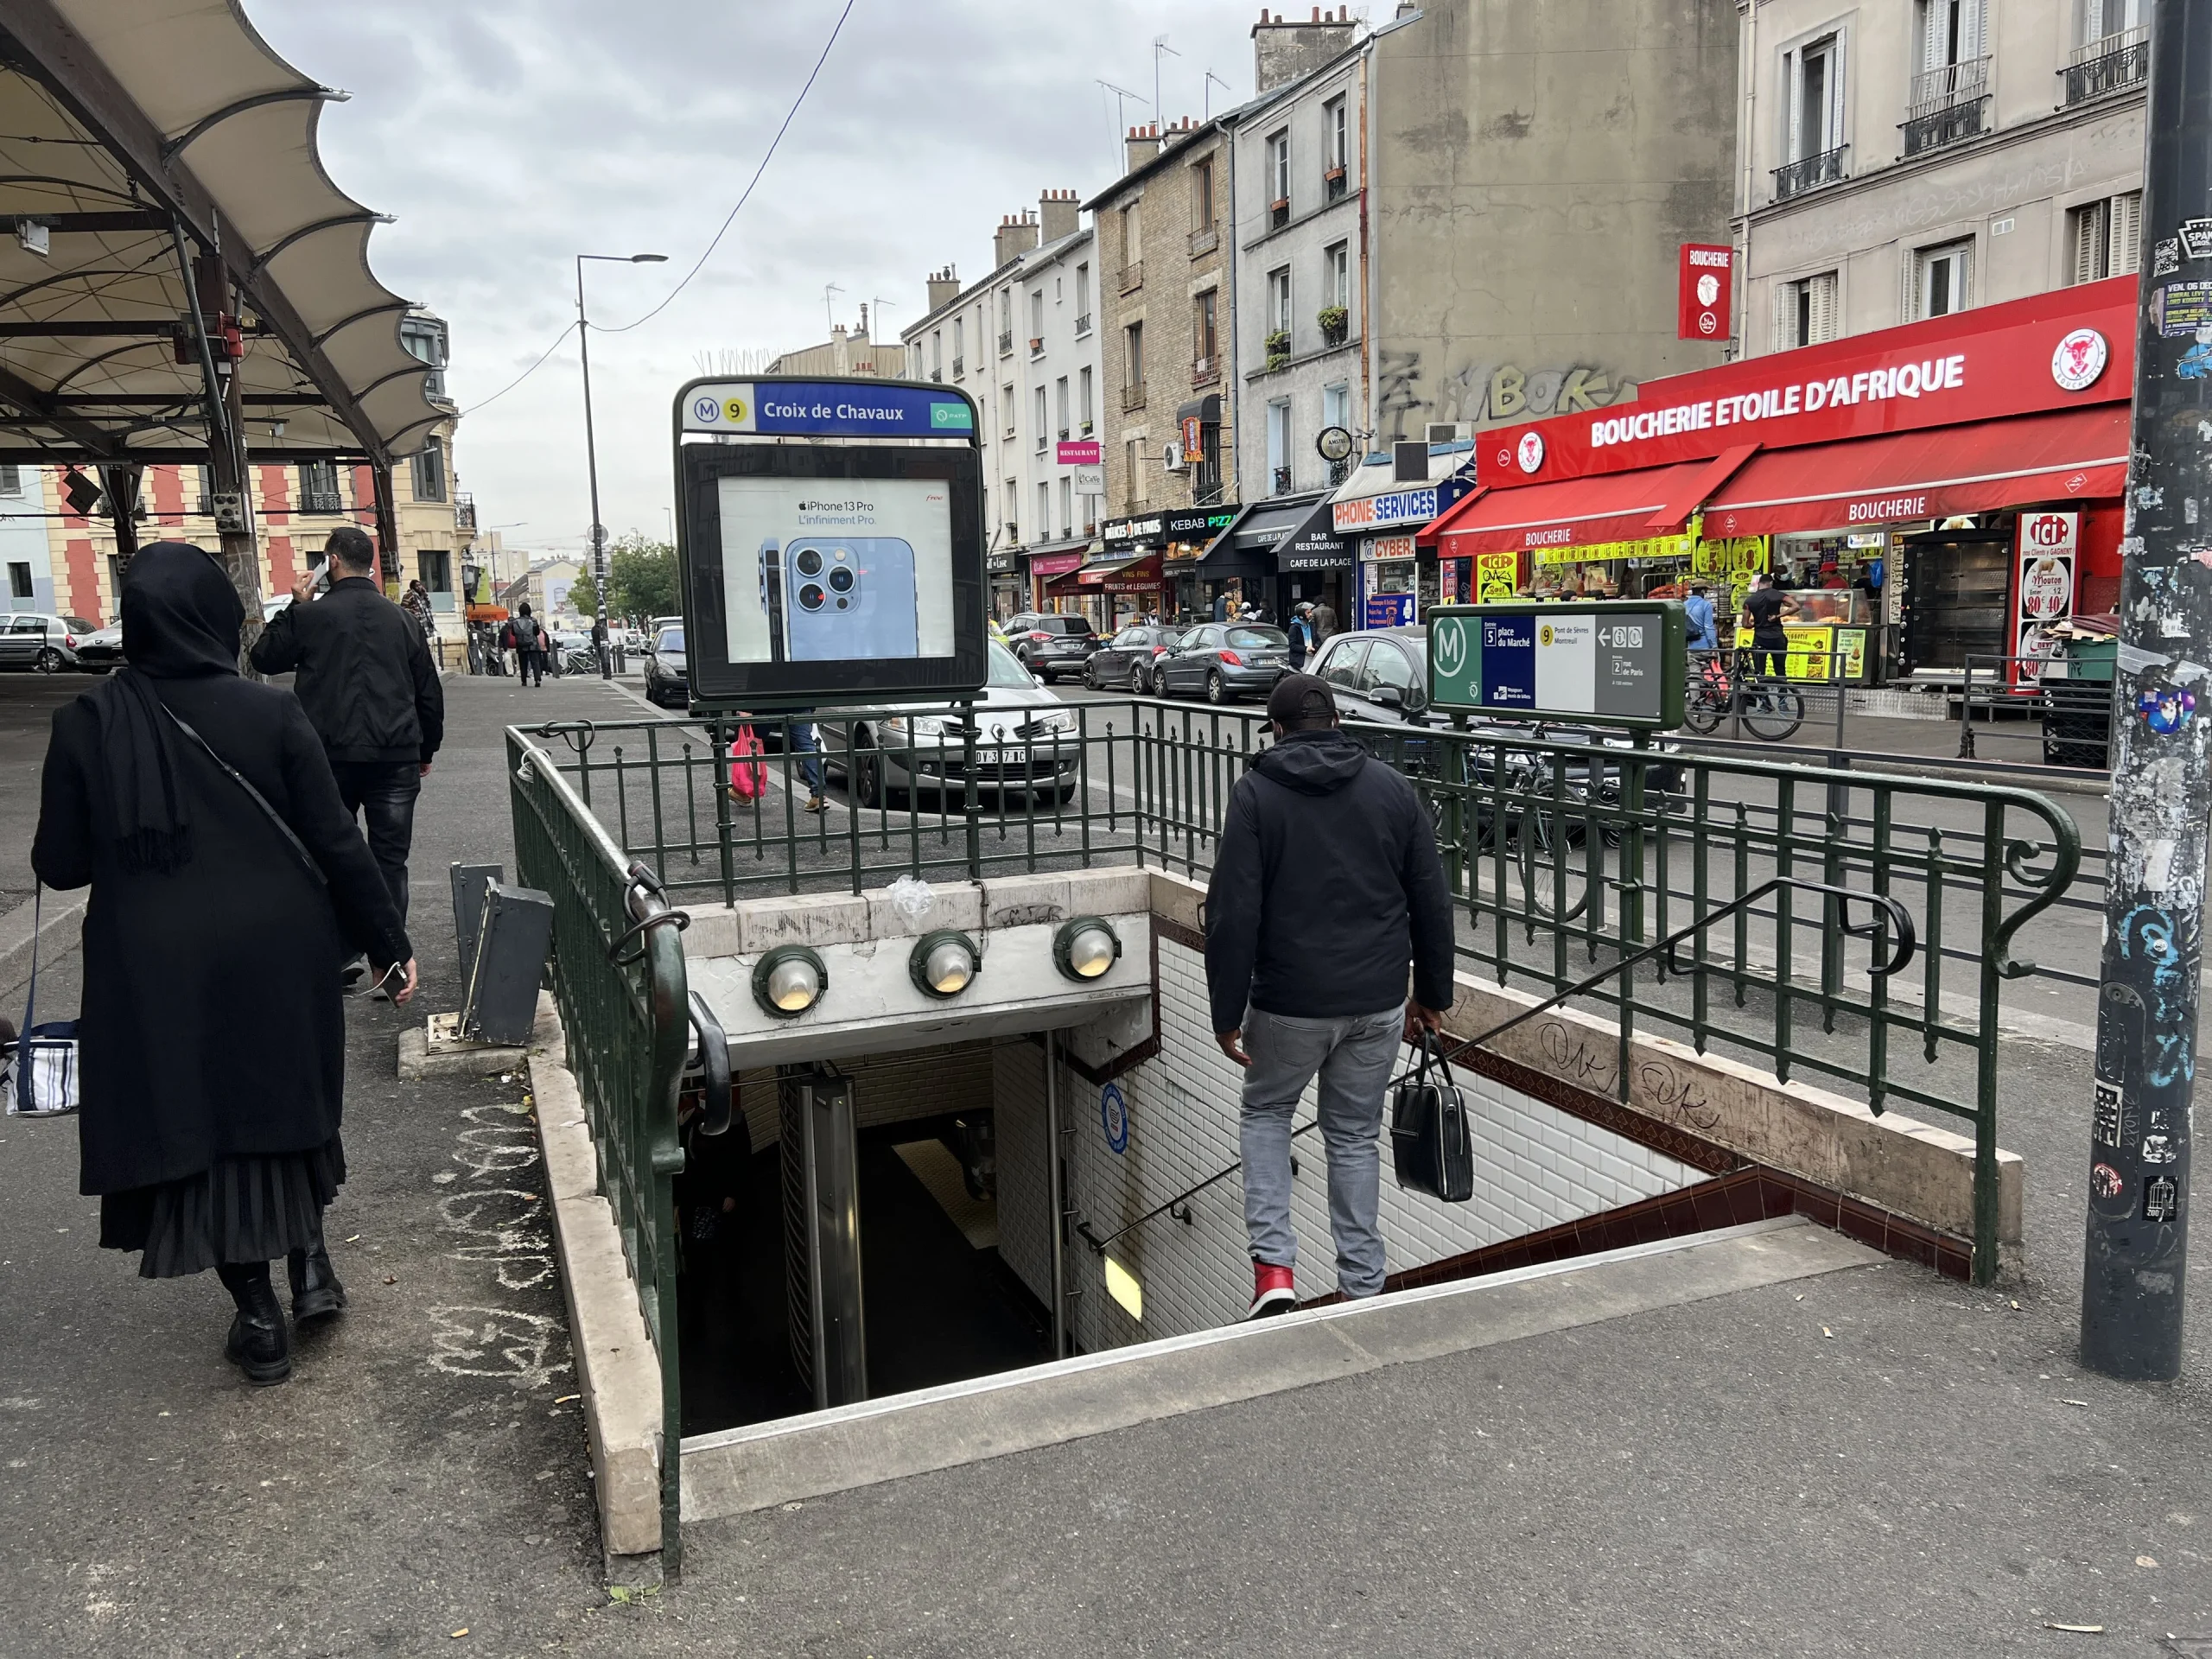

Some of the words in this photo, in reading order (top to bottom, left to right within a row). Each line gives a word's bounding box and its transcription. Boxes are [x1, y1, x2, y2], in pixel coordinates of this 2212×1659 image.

[1689, 250, 1729, 267] BOUCHERIE
[2168, 283, 2185, 292] VEN.
[1591, 401, 1713, 448] BOUCHERIE
[1715, 385, 1801, 427] ETOILE
[1804, 354, 1965, 412] D'AFRIQUE
[729, 404, 741, 418] 9
[764, 403, 806, 418] Croix
[811, 403, 831, 418] de
[836, 404, 904, 420] Chavaux
[807, 501, 842, 512] iPhone
[844, 501, 855, 512] 13
[857, 501, 874, 512] Pro
[1849, 497, 1925, 521] BOUCHERIE
[857, 516, 876, 524] Pro.
[1171, 518, 1205, 531] KEBAB
[1133, 524, 1143, 537] DE
[1143, 519, 1161, 535] PARIS
[1525, 528, 1571, 546] BOUCHERIE
[1295, 542, 1344, 550] RESTAURANT
[1376, 537, 1414, 557] CYBER.
[2031, 548, 2045, 556] Clients
[2050, 547, 2072, 556] GAGNENT
[1290, 559, 1308, 568] CAFE
[1330, 557, 1351, 566] PLACE
[1104, 582, 1125, 591] FRUITS
[1134, 582, 1161, 590] LEGUMES
[2032, 575, 2062, 588] Mouton
[1488, 631, 1493, 643] 5
[1497, 627, 1515, 638] place
[1543, 629, 1549, 643] 9
[1439, 627, 1457, 662] M
[1507, 638, 1530, 647] Marché
[1615, 662, 1620, 672] 2
